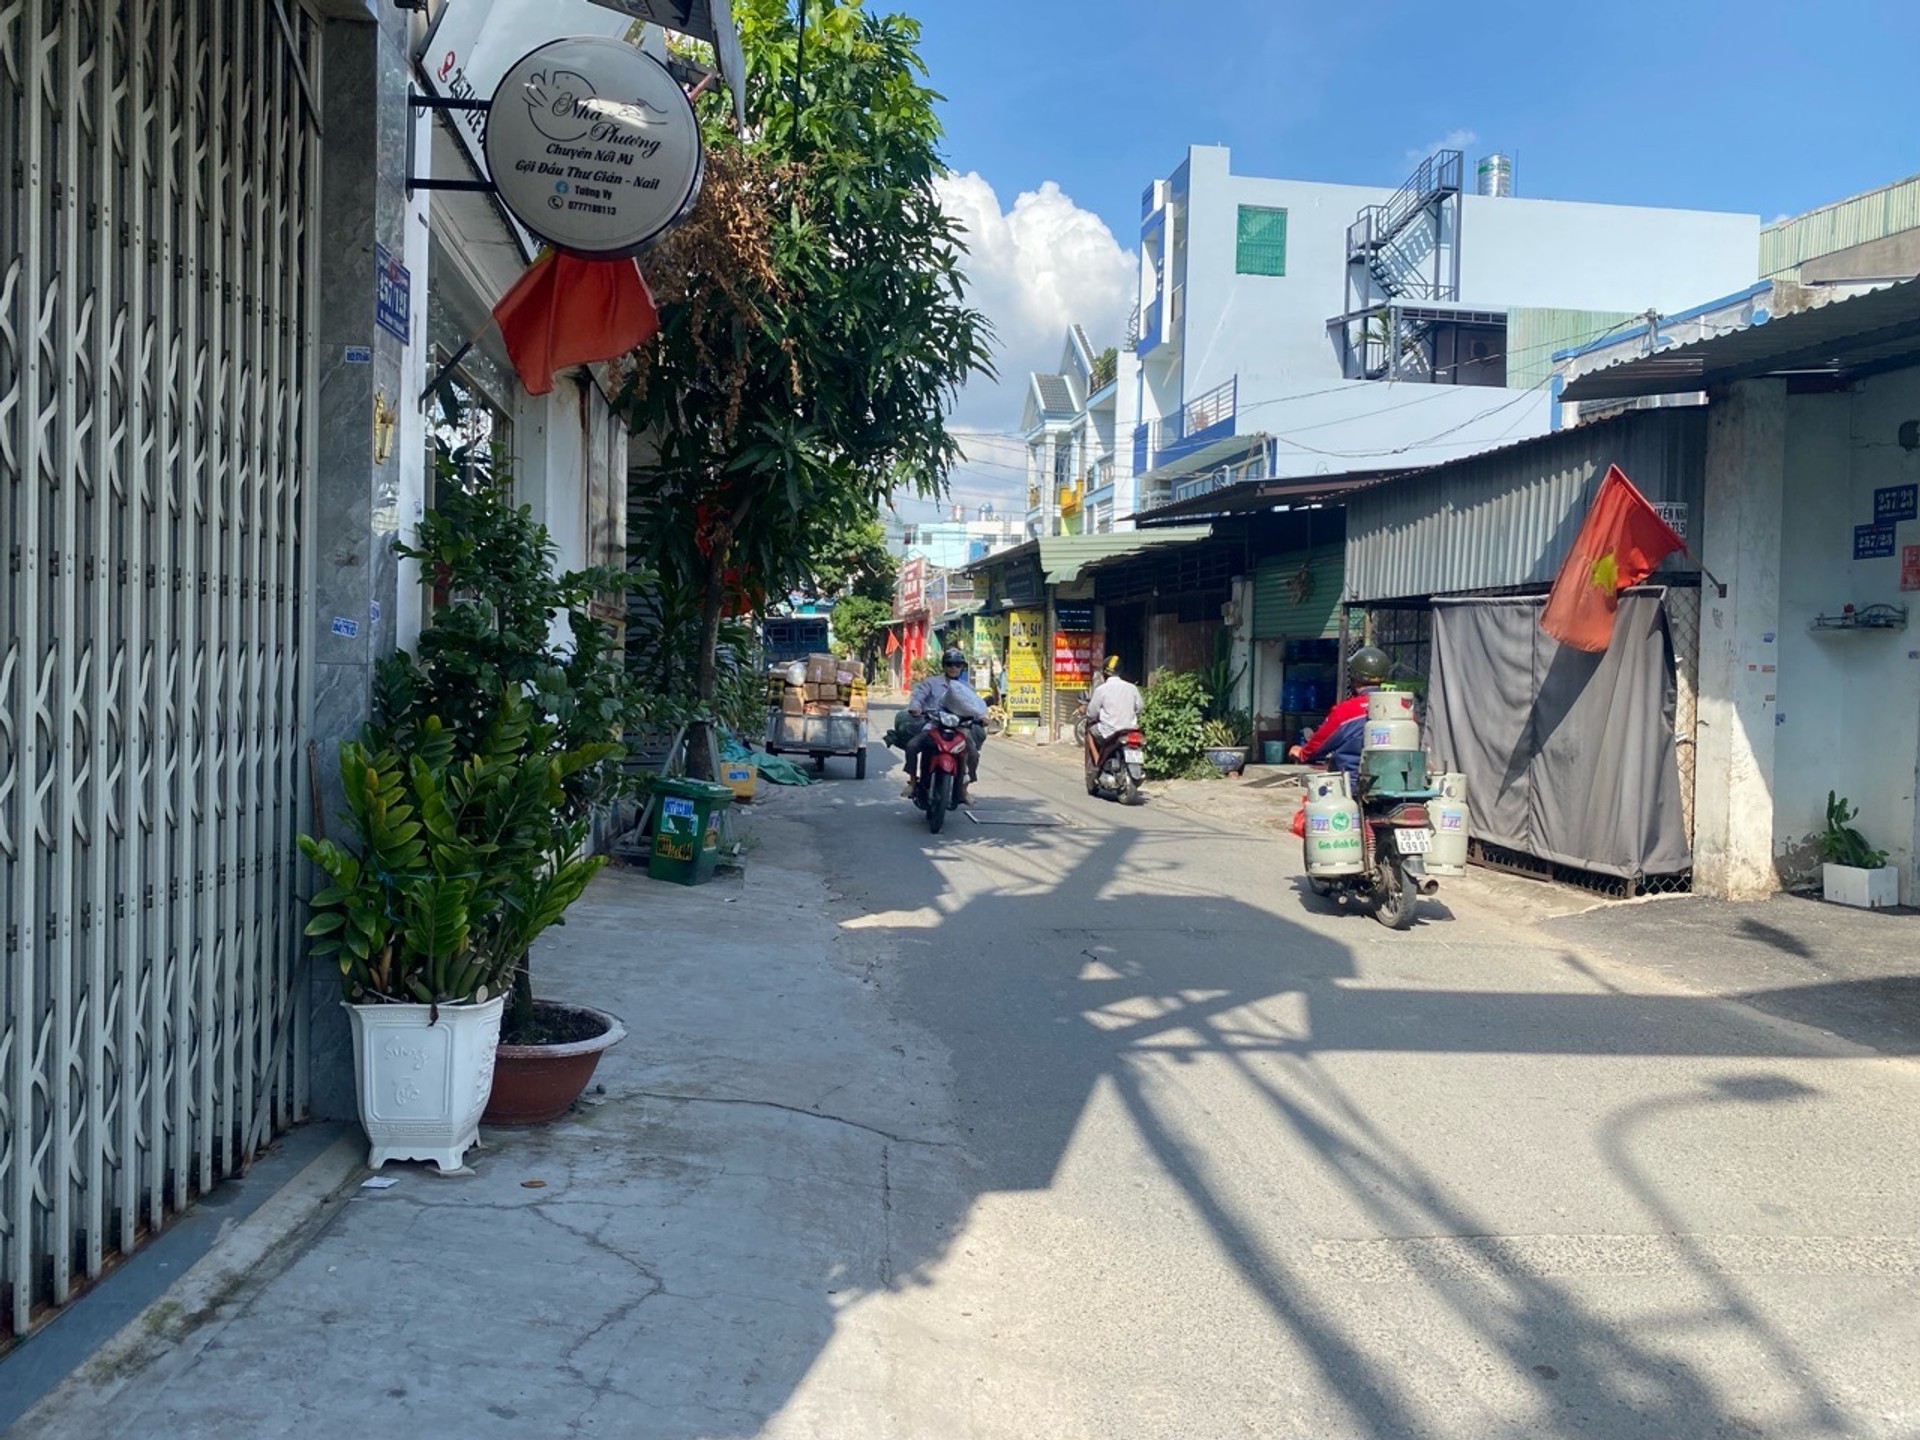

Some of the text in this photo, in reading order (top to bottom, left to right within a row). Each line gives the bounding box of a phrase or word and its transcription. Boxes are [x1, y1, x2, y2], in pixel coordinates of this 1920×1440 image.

[546, 142, 592, 161] Chuyên
[617, 153, 634, 166] Mi
[567, 166, 591, 180] Thư
[633, 176, 660, 190] Nail
